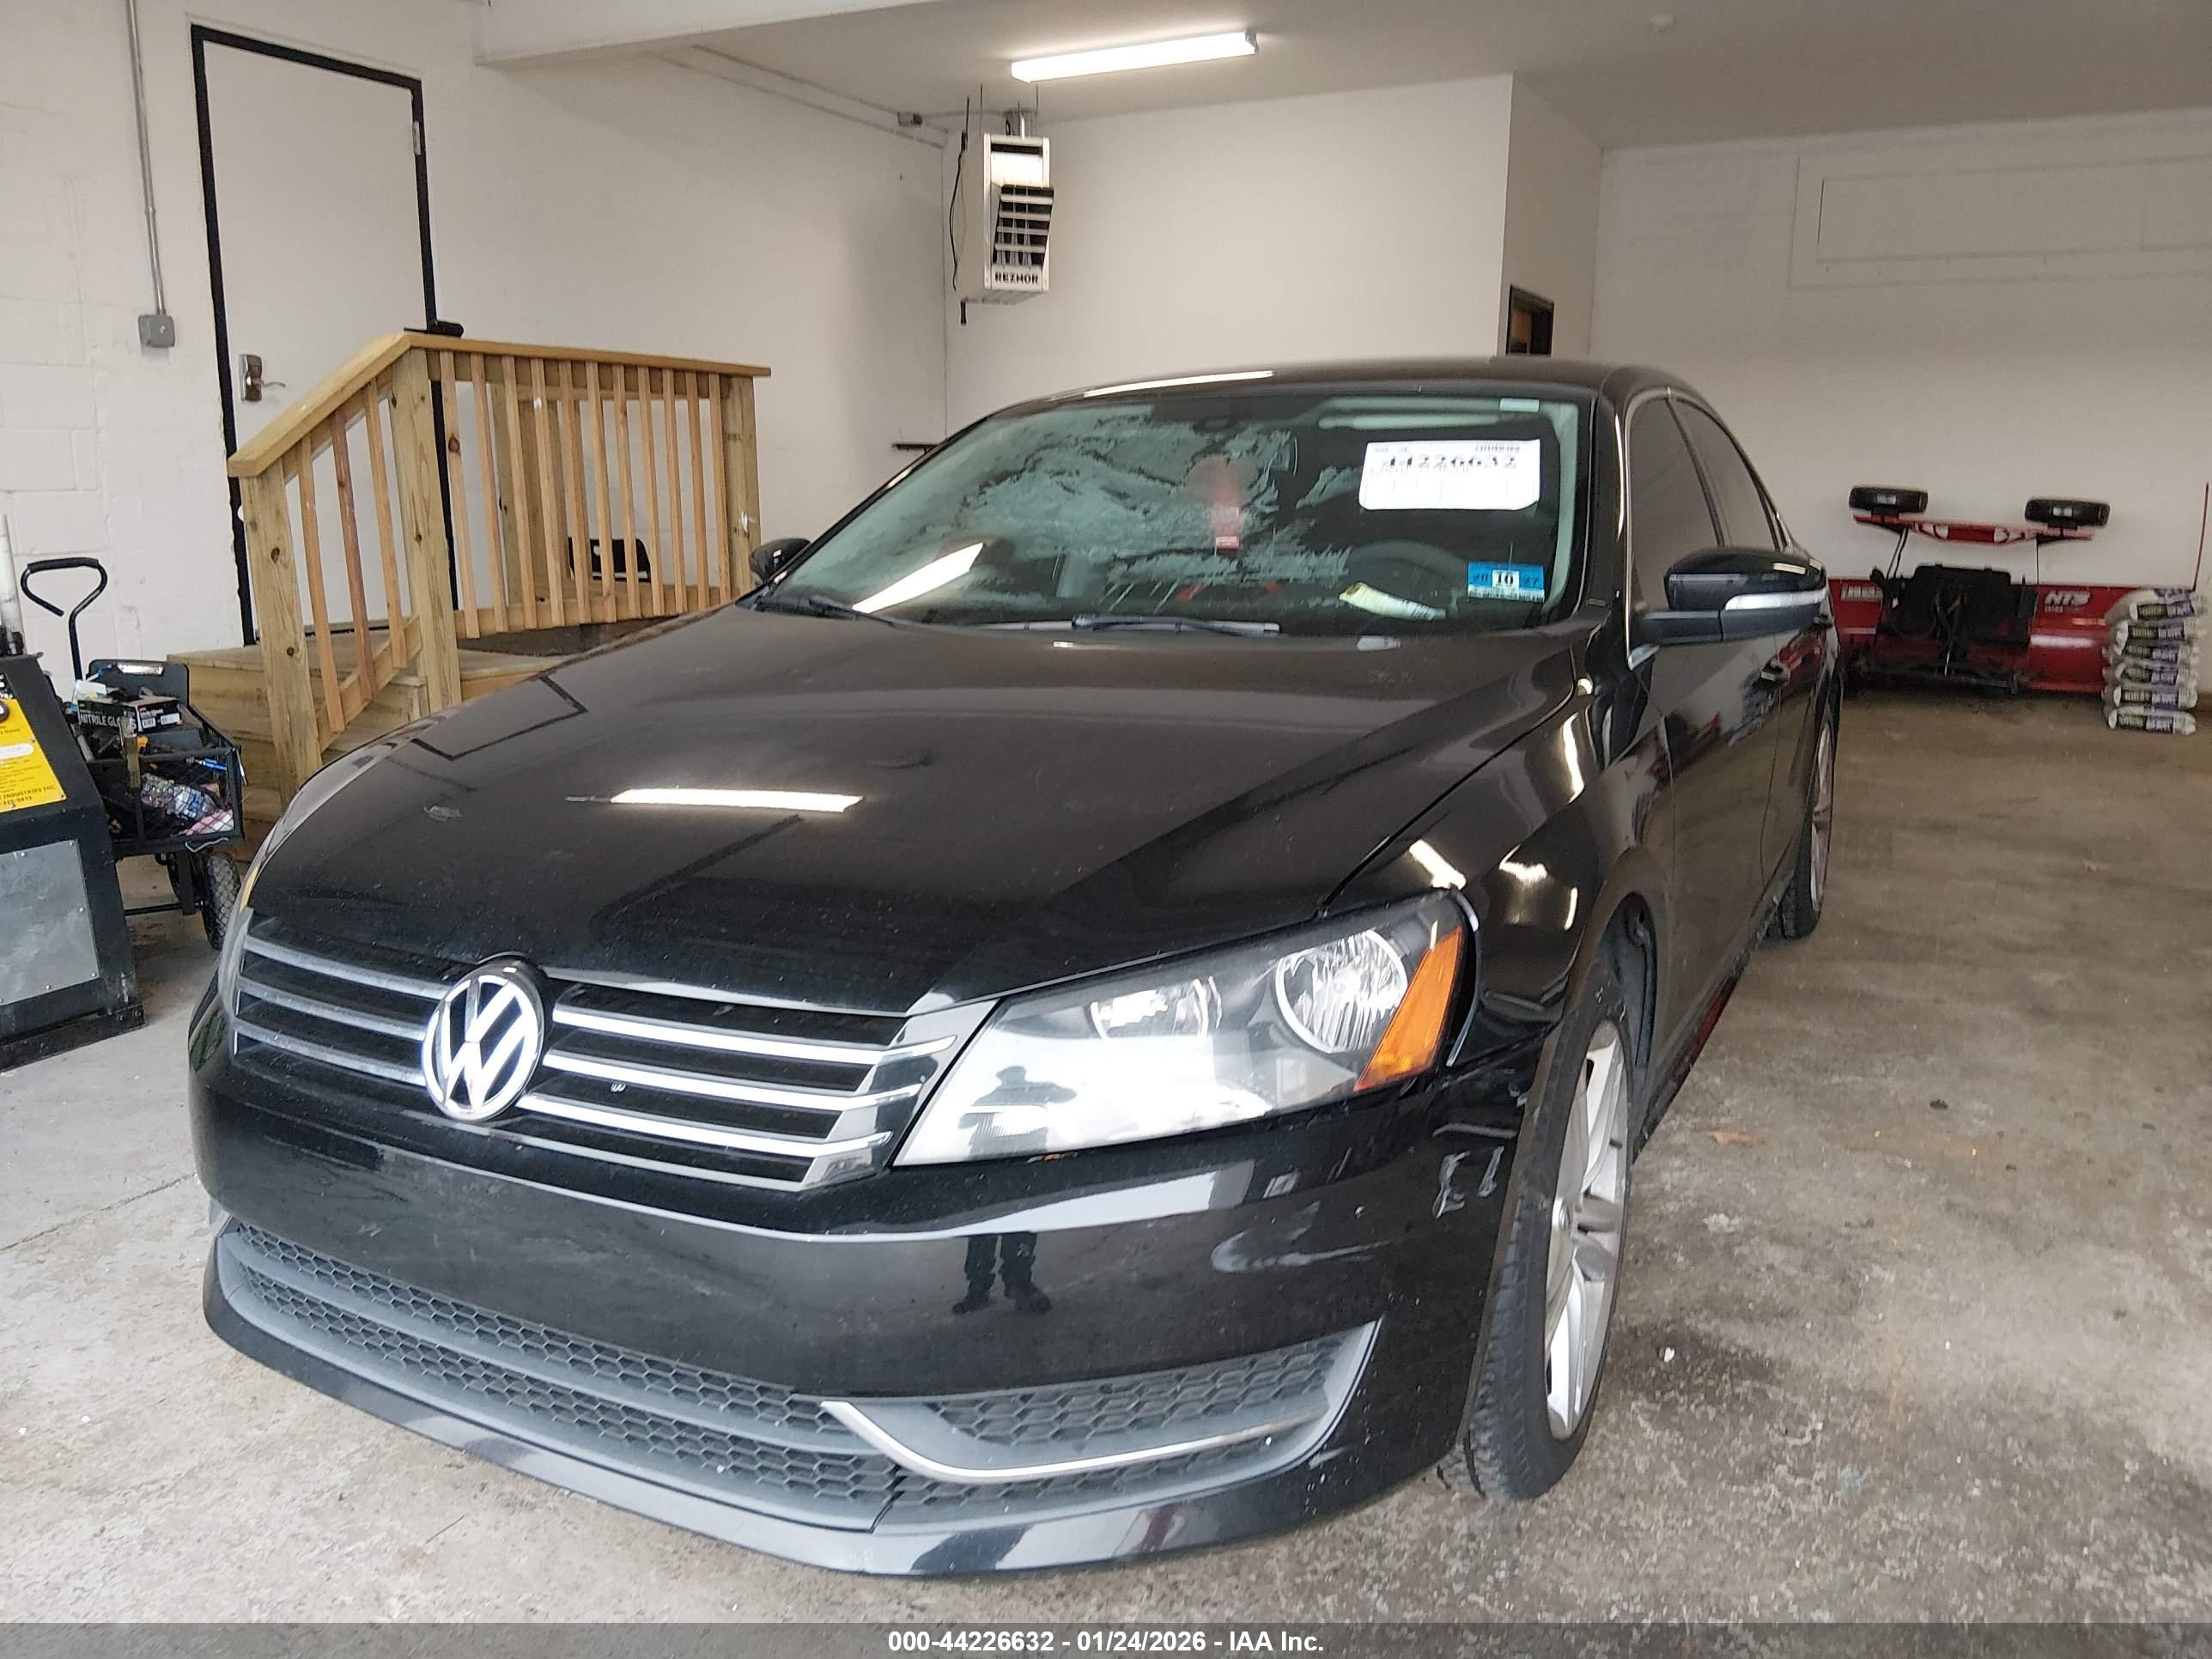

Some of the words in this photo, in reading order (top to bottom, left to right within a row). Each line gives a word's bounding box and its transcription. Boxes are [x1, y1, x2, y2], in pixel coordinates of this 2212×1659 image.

[994, 272, 1038, 284] REZNOR
[1497, 572, 1514, 586] 10
[80, 714, 107, 726] NITRILE
